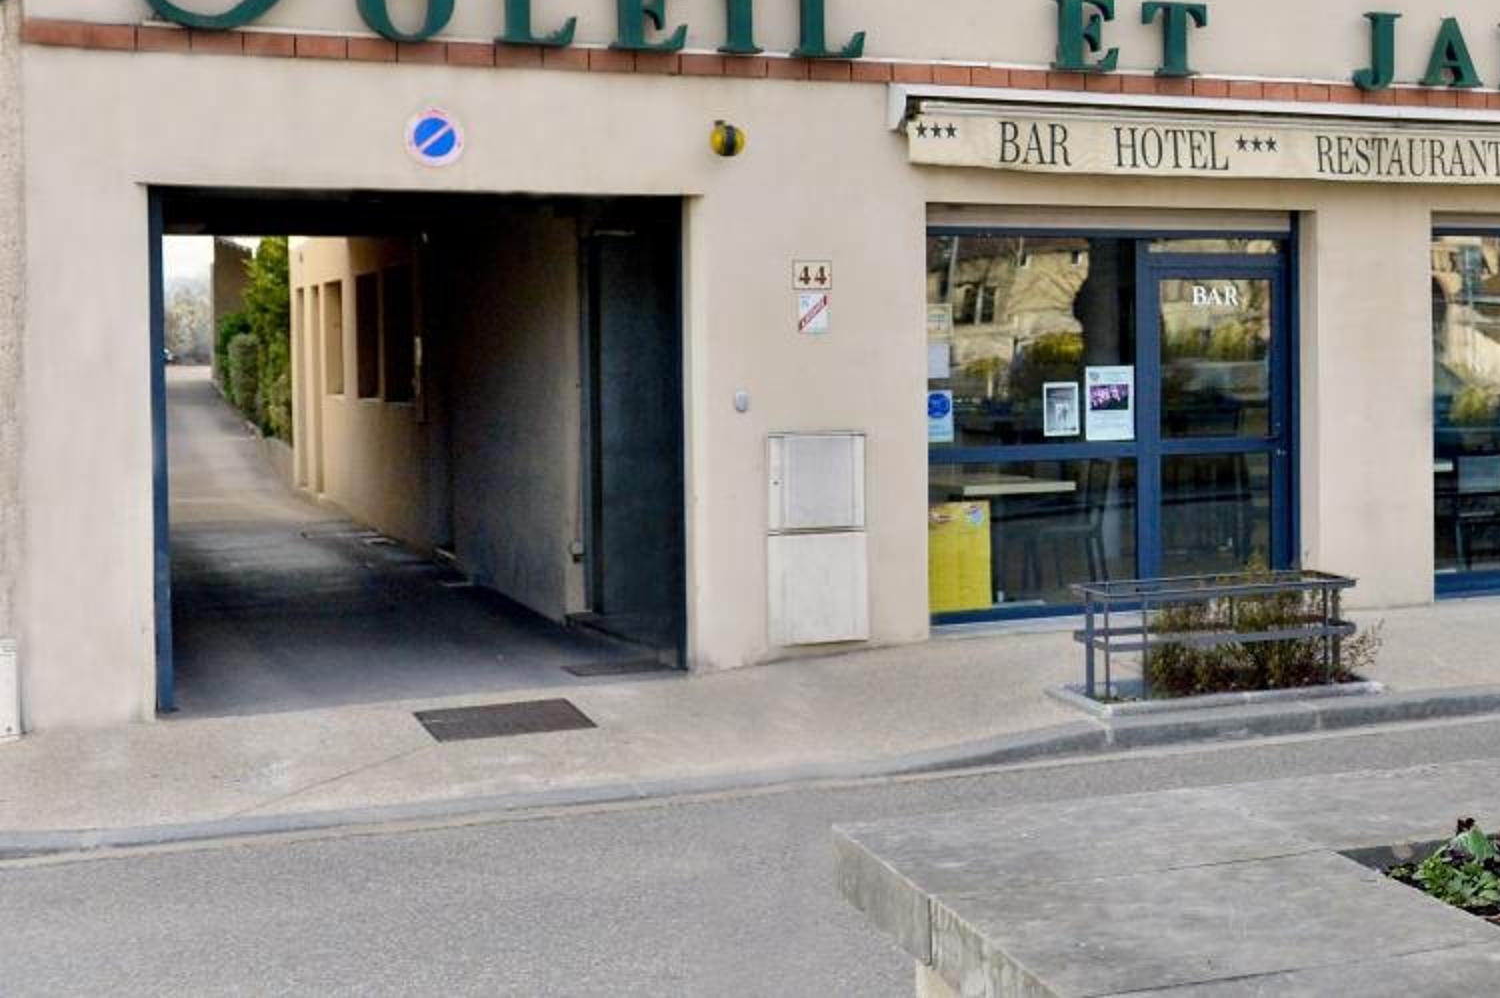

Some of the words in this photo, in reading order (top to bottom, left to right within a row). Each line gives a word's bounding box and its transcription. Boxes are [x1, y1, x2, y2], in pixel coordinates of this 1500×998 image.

[999, 121, 1072, 166] BAR
[1113, 127, 1230, 171] HOTEL
[799, 265, 828, 285] 44
[1191, 286, 1240, 307] BAR
